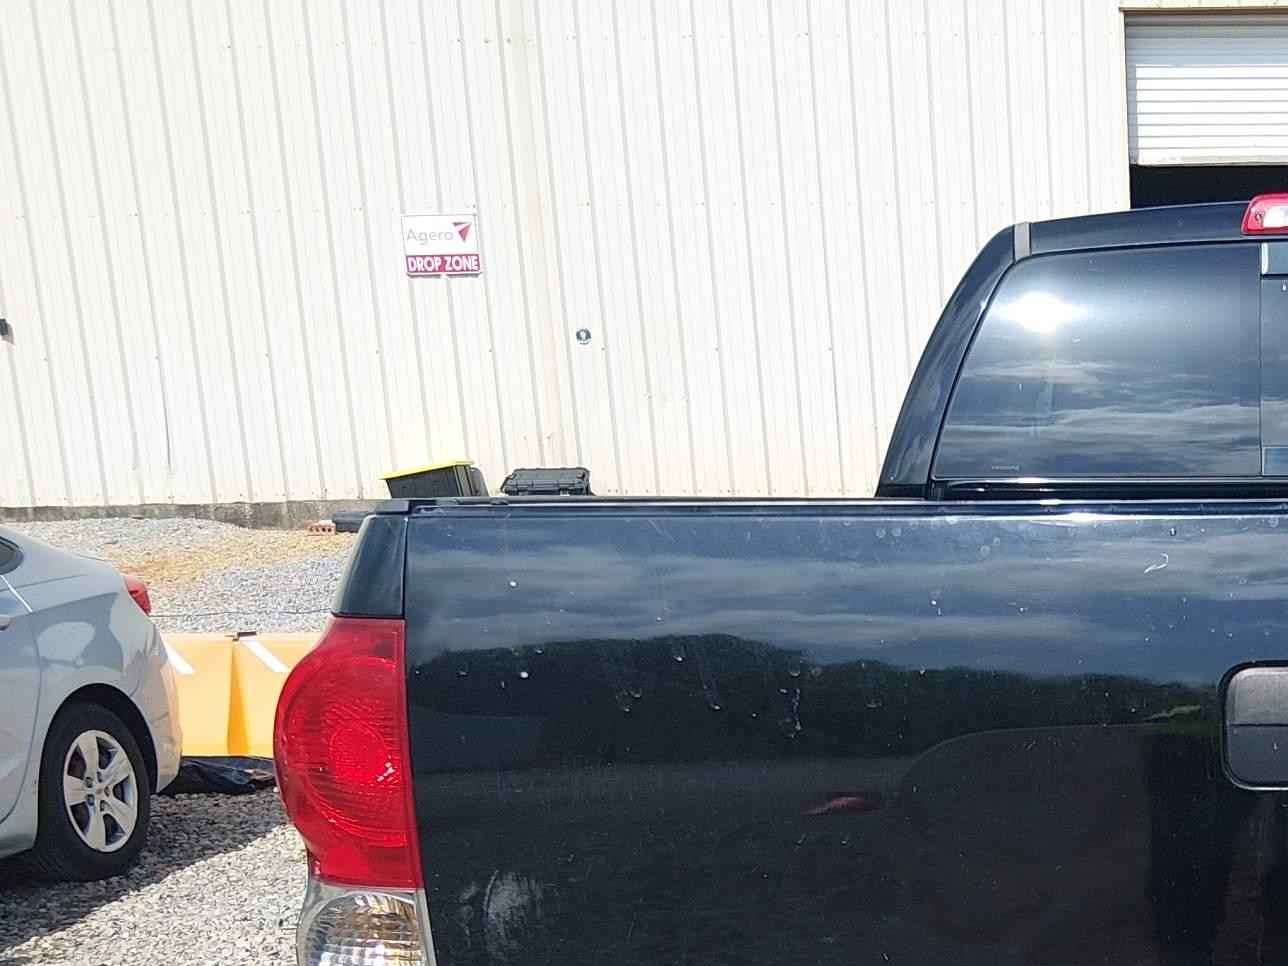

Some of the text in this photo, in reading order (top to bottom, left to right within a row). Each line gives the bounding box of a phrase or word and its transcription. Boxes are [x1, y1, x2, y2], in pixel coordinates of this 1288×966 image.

[406, 228, 454, 246] Agero
[407, 255, 480, 273] DROP ZONE
